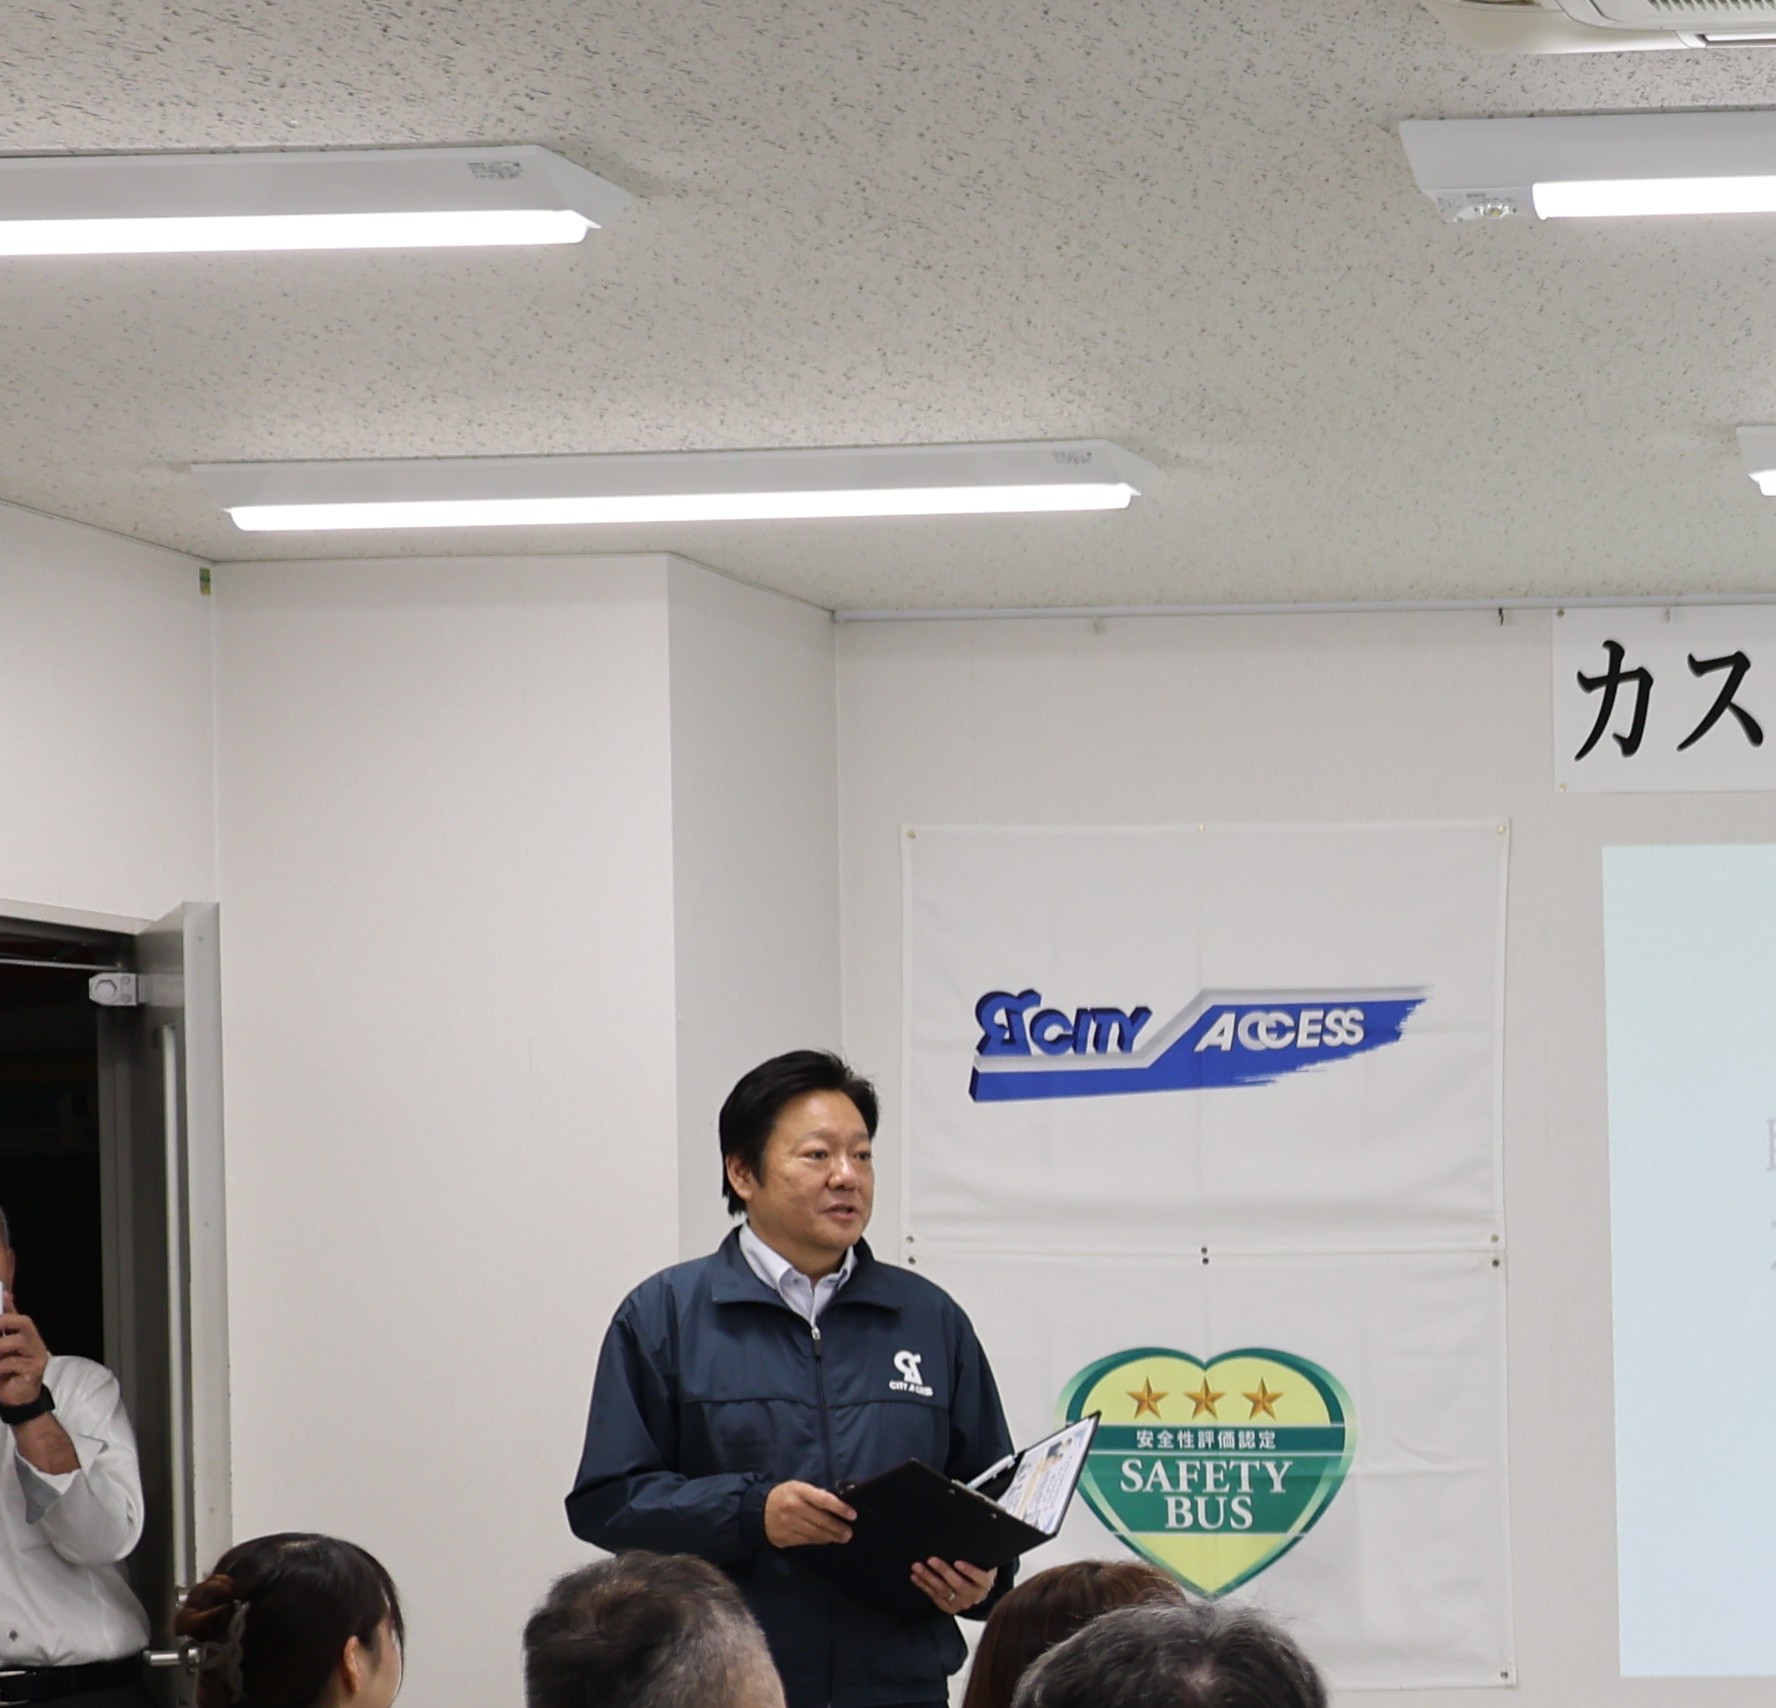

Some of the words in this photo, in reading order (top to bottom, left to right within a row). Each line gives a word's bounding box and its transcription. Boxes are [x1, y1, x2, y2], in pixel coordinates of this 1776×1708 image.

[1029, 1006, 1154, 1056] CITY
[1193, 1007, 1366, 1052] ACCESS
[1136, 1429, 1276, 1450] 安全性評価認定
[1120, 1458, 1294, 1494] SAFETY
[1164, 1495, 1254, 1530] BUS
